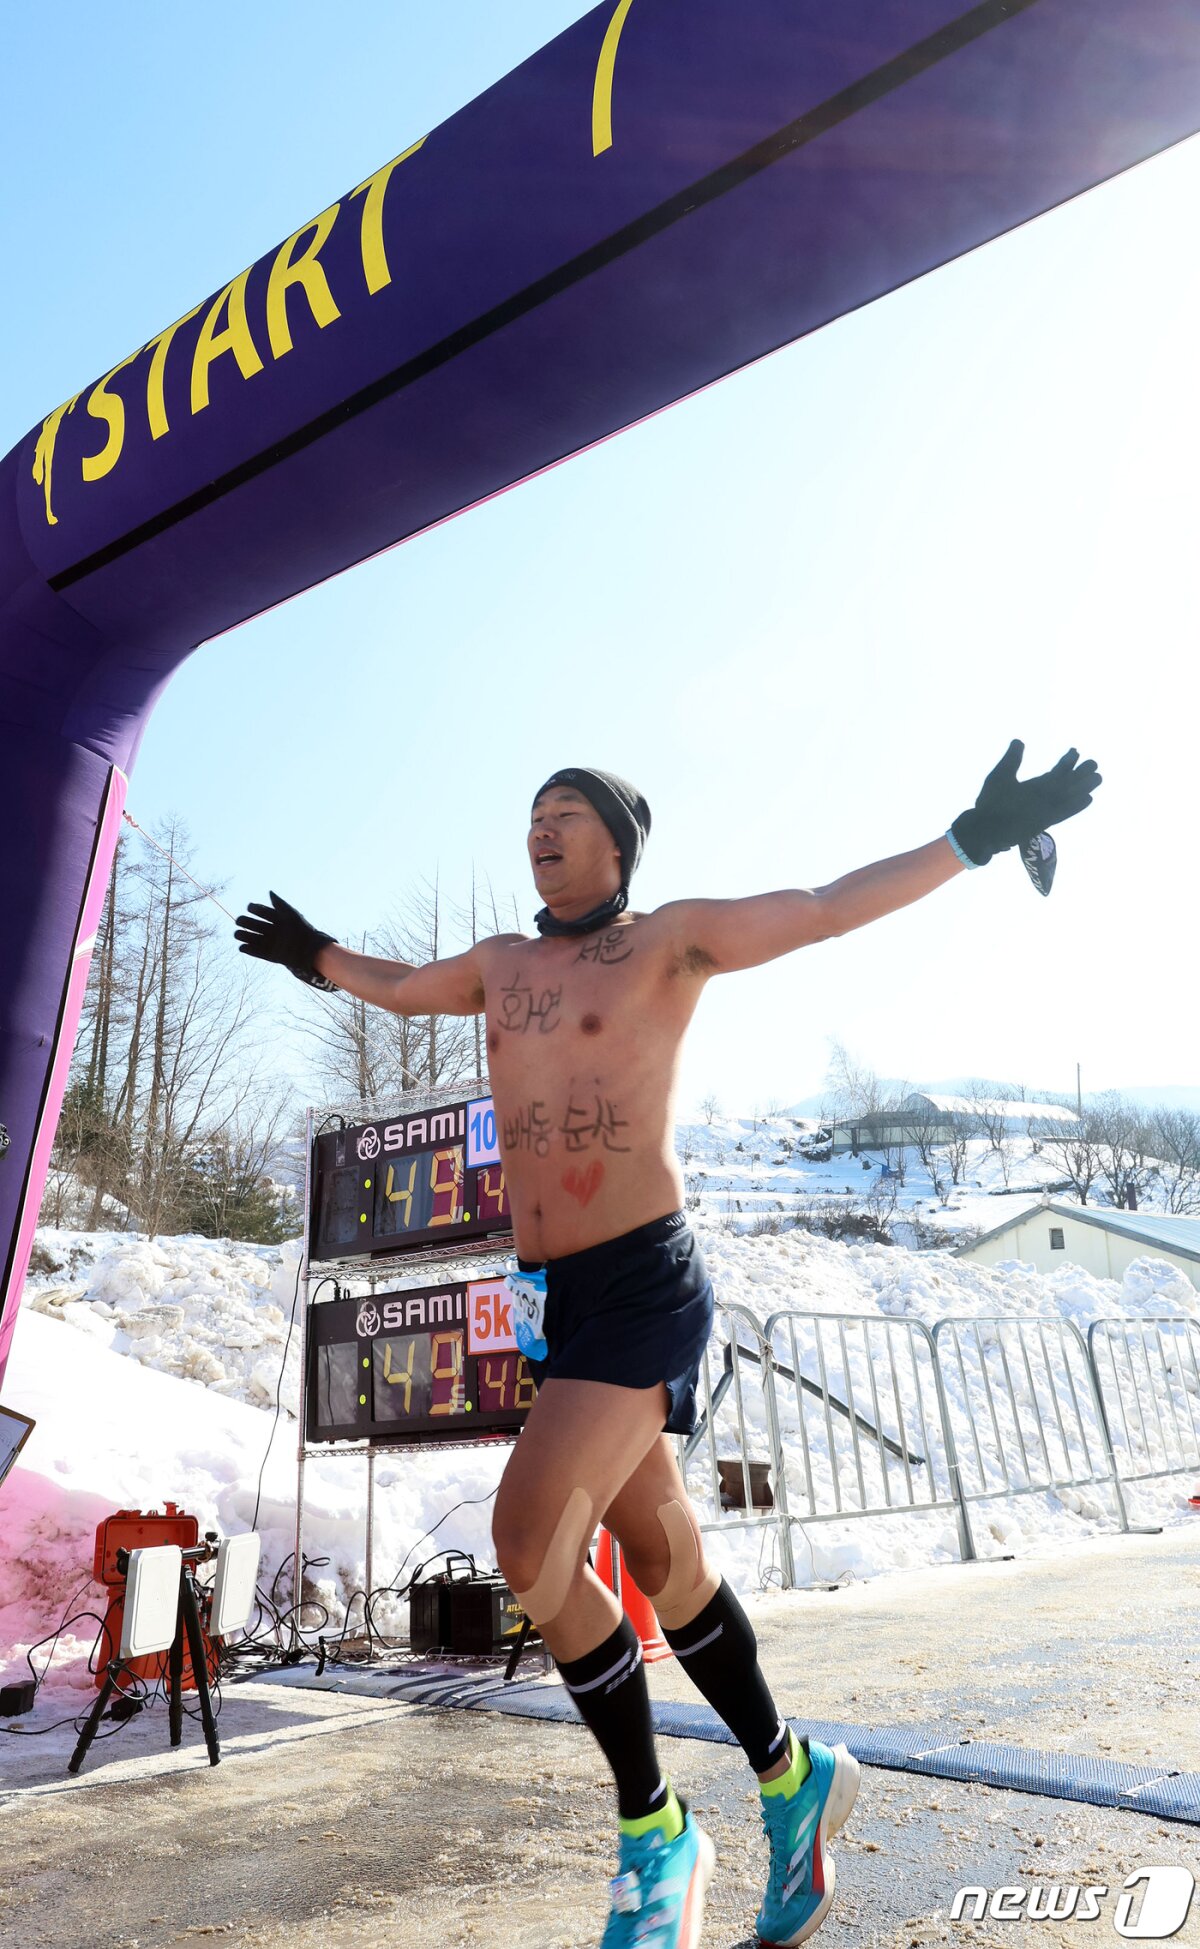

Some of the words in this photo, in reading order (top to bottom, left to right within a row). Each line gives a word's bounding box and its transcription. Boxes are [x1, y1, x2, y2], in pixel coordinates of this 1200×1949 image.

[81, 132, 430, 482] START
[571, 929, 634, 965] 서윤
[383, 1292, 469, 1329] SAMI
[474, 1293, 515, 1340] 5k
